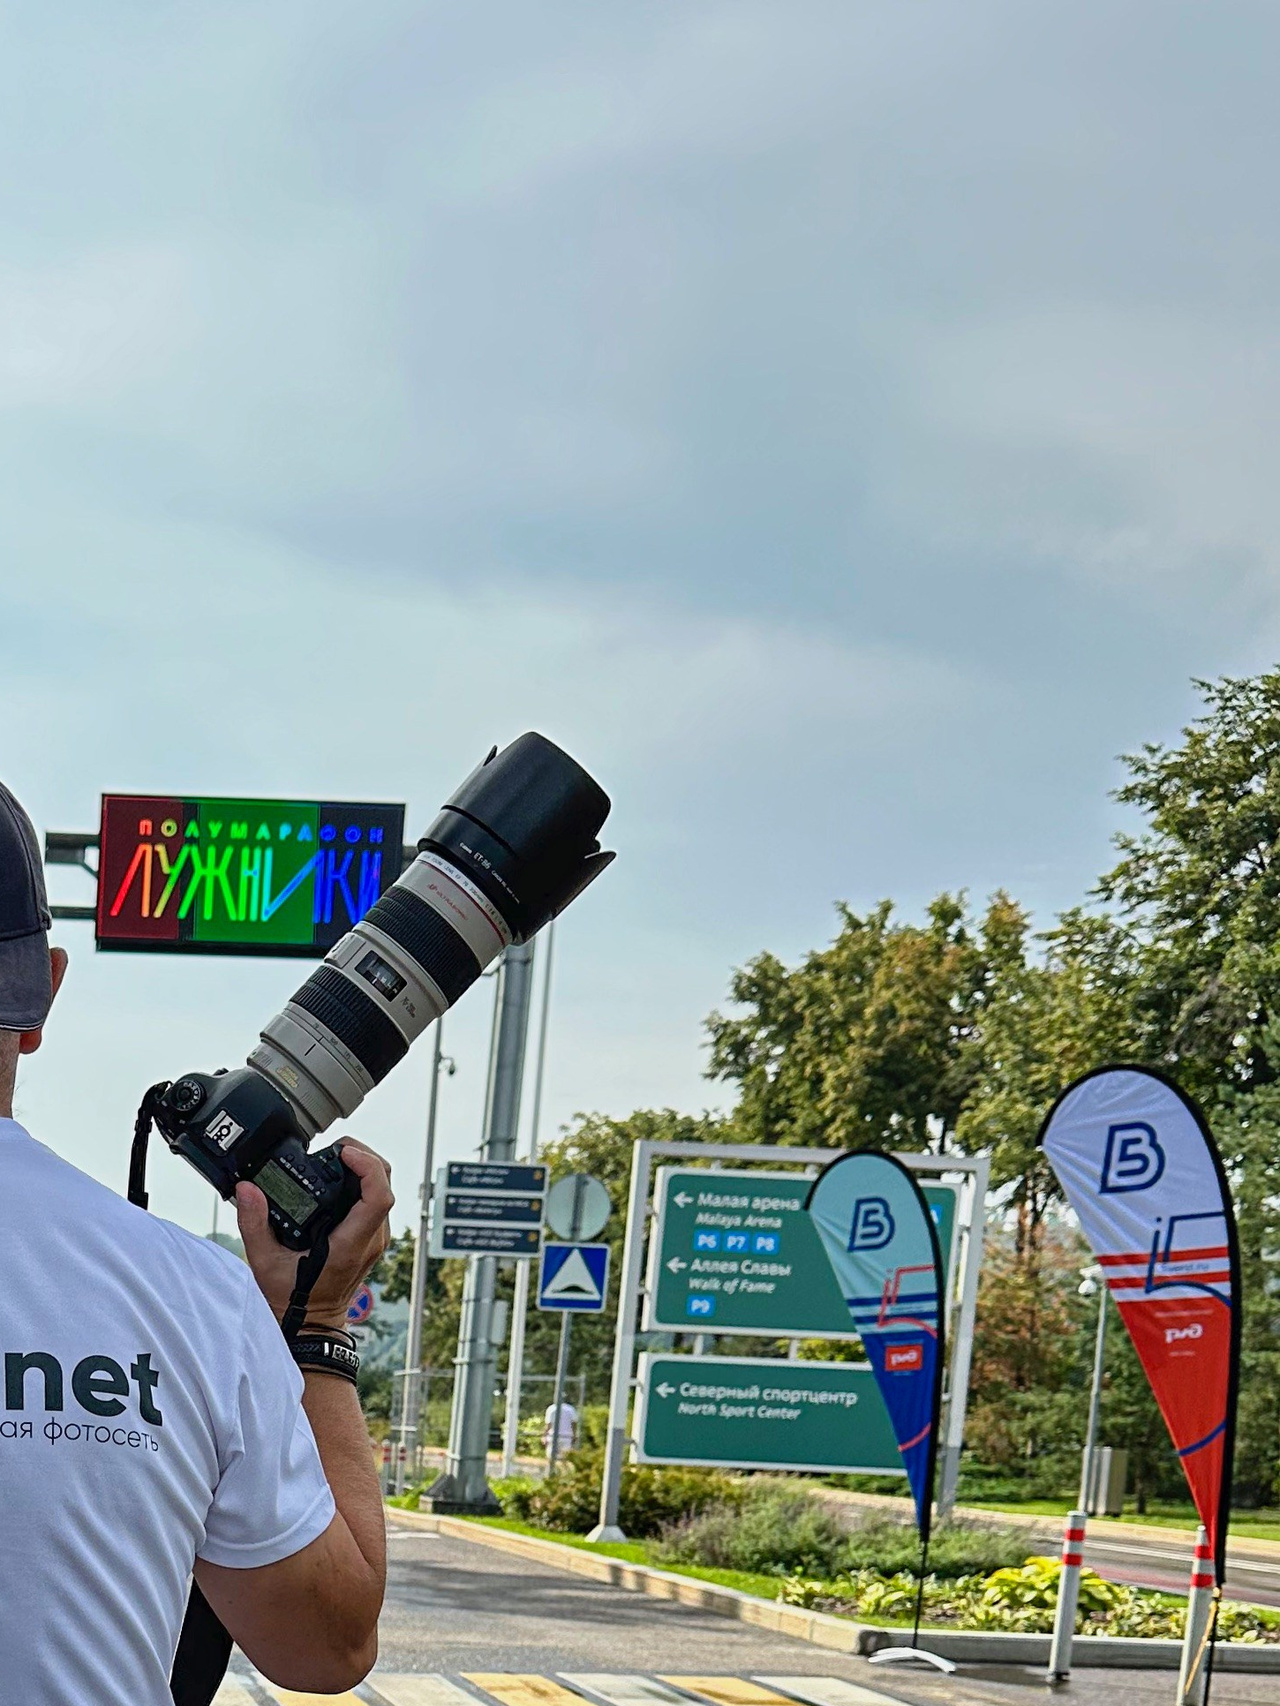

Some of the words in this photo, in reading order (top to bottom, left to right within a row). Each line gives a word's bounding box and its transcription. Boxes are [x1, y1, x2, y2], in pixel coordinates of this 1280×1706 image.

[110, 842, 382, 924] ЛУЖНИКИ
[697, 1192, 749, 1209] Малая
[751, 1196, 801, 1212] арена
[695, 1212, 742, 1229] Malaya
[743, 1214, 782, 1228] Arena
[697, 1233, 717, 1248] P6
[726, 1235, 746, 1249] P7
[756, 1236, 775, 1252] P8
[690, 1258, 739, 1273] Аллея
[741, 1260, 792, 1276] Славы
[688, 1278, 721, 1291] Walk
[722, 1278, 740, 1295] of
[739, 1279, 776, 1294] Fame
[691, 1298, 710, 1314] P9
[679, 1382, 760, 1401] Северный
[762, 1388, 858, 1408] спортцентр
[677, 1402, 717, 1416] North
[719, 1403, 756, 1419] Sport
[756, 1405, 801, 1420] Center
[43, 1416, 160, 1452] фотосеть
